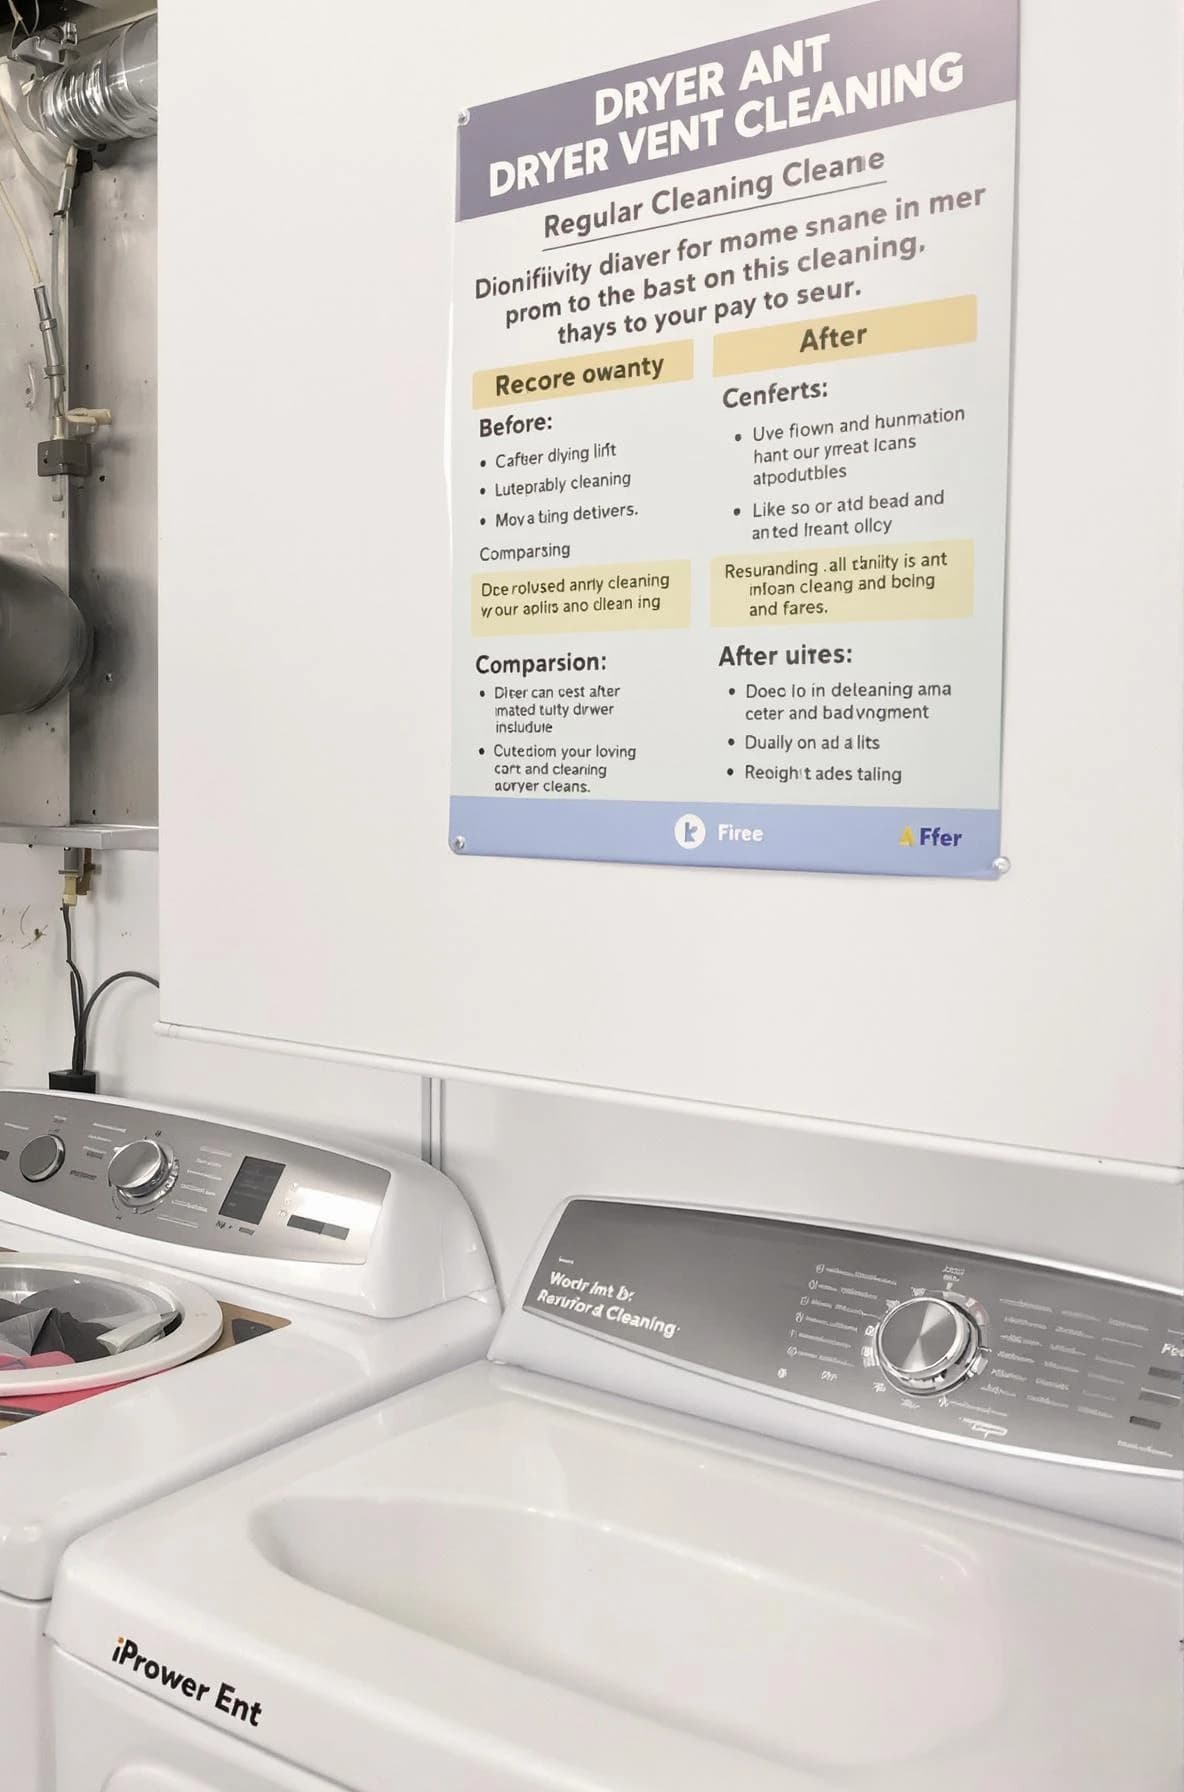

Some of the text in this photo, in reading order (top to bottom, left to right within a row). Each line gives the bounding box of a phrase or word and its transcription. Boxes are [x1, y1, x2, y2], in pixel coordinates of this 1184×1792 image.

[594, 34, 831, 126] DRYER ANT
[489, 51, 964, 197] DRYER VENT CLEANING
[544, 152, 885, 238] Regular Cleaning Cleane
[600, 252, 670, 276] diaver
[678, 238, 712, 261] for
[720, 225, 798, 253] mome
[806, 207, 887, 237] snane
[896, 198, 919, 221] in
[930, 187, 986, 215] mer
[506, 235, 926, 328] prom to the bast on this cleaning,
[558, 280, 862, 345] thays to your pay to seur.
[799, 326, 868, 353] After
[495, 357, 665, 397] Recore owanty
[722, 381, 828, 409] Cenferts:
[478, 412, 552, 438] Before:
[753, 425, 784, 442] Uve
[839, 415, 869, 432] and
[753, 447, 788, 464] hant
[793, 446, 820, 460] our
[570, 471, 632, 490] cleaning
[752, 502, 785, 518] Like
[791, 503, 810, 515] so
[815, 500, 832, 514] or
[869, 492, 909, 509] bead
[914, 489, 945, 507] and
[904, 553, 916, 568] is
[920, 550, 948, 568] ant
[608, 573, 670, 590] cleaning
[800, 577, 853, 595] cleang
[858, 575, 887, 591] and
[749, 600, 828, 617] and fares.
[476, 652, 607, 678] Comparsion:
[718, 644, 778, 668] After
[531, 688, 554, 699] can
[811, 682, 826, 698] in
[831, 681, 913, 700] deleaning
[744, 705, 784, 721] ceter
[789, 704, 818, 720] and
[561, 748, 592, 760] your
[596, 744, 637, 761] loving
[744, 734, 793, 752] Dually
[797, 737, 817, 750] on
[821, 735, 840, 750] ad
[856, 735, 881, 751] lits
[524, 762, 549, 775] and
[815, 766, 854, 781] ades
[856, 766, 903, 785] taling
[543, 780, 591, 793] cleans.
[717, 823, 764, 842] Firee
[919, 827, 963, 847] Ffer
[112, 1636, 263, 1728] iPrower Ent
